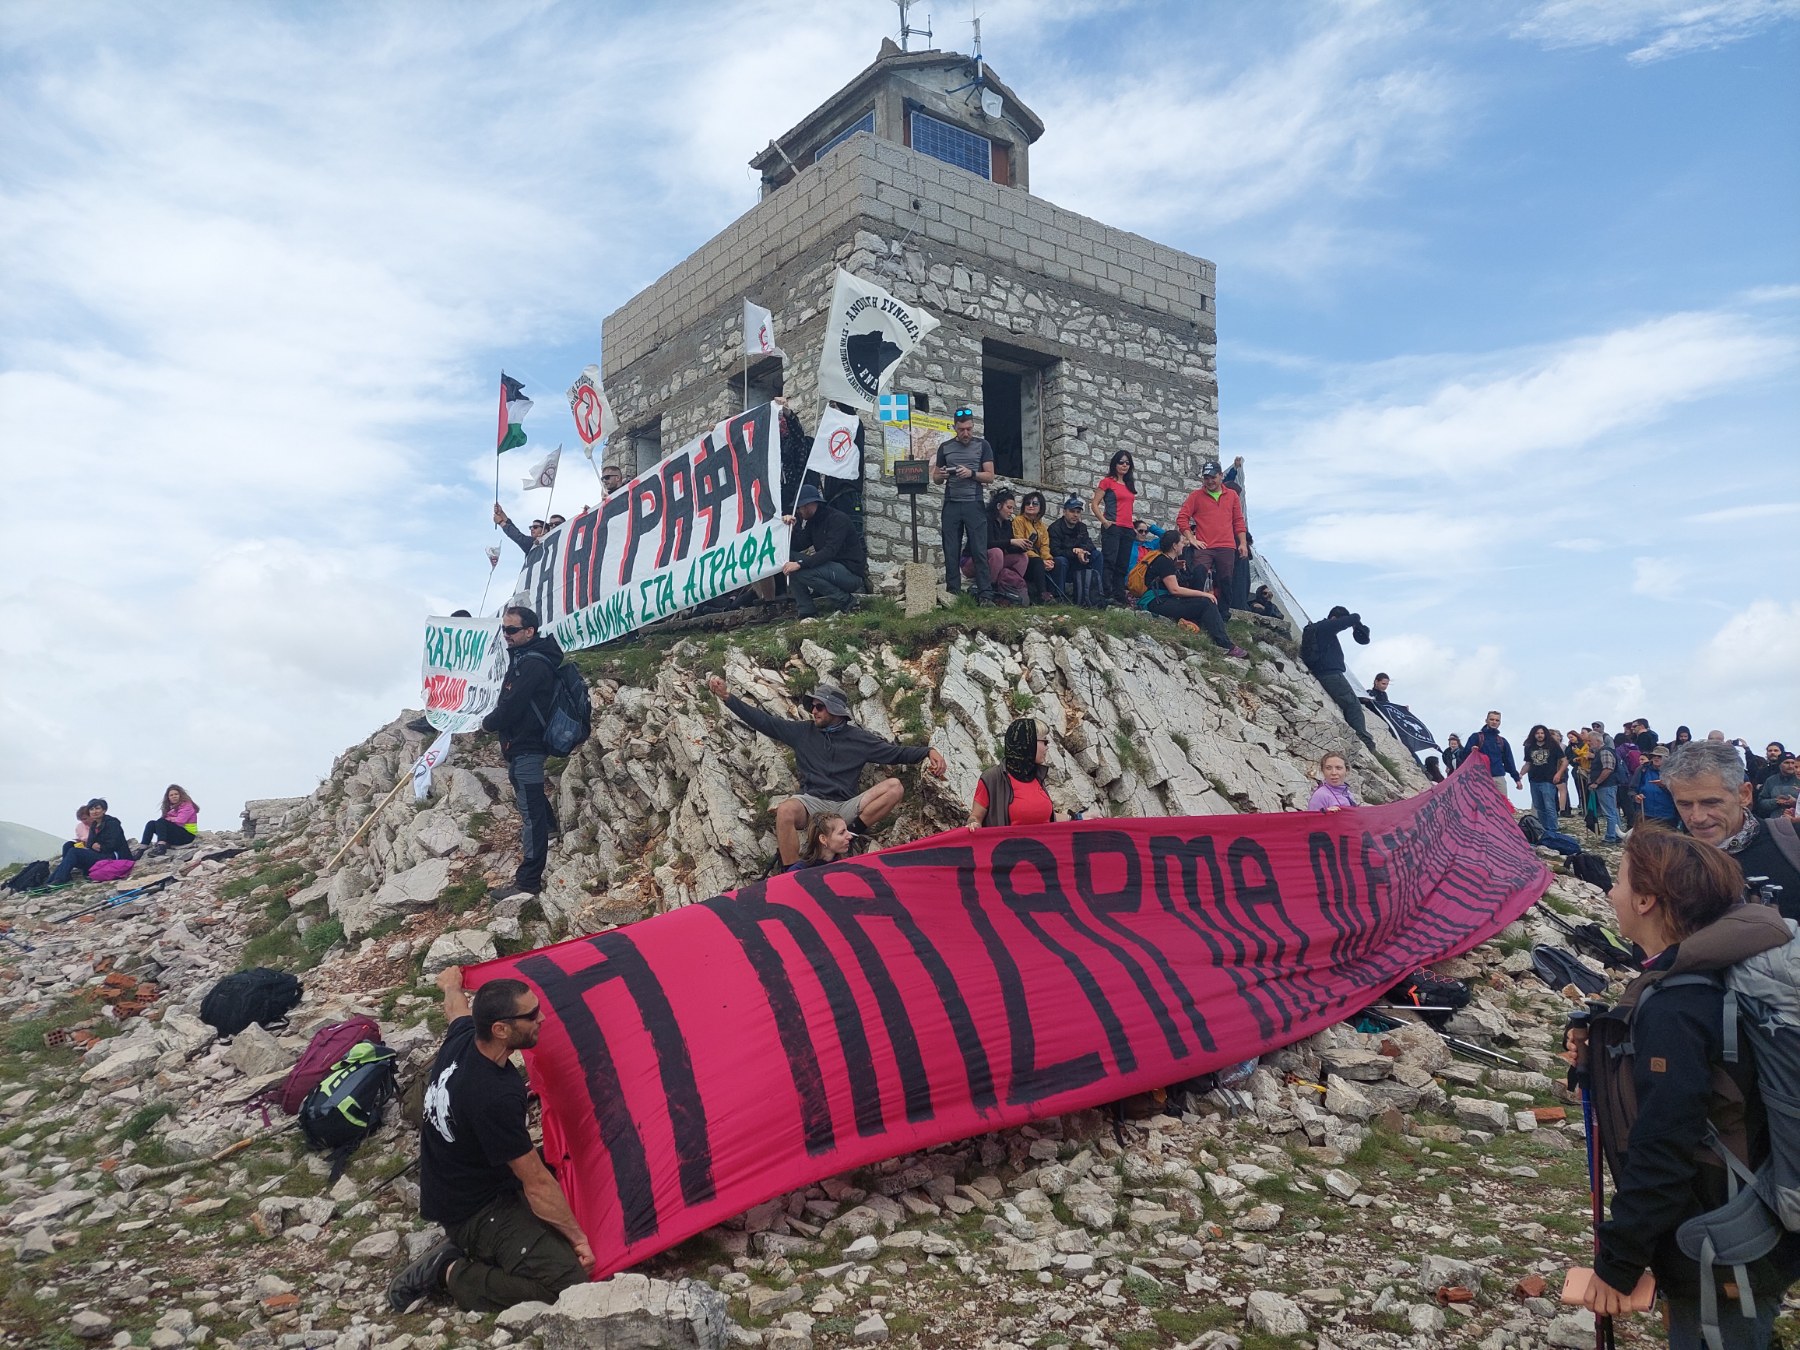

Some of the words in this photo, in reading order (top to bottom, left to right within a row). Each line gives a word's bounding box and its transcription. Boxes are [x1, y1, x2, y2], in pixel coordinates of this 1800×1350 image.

[562, 401, 777, 615] ΑΓΡΑΦΑ
[585, 588, 636, 644] ΑΙΟΛΙΚΑ
[640, 570, 677, 623] ΣΤΑ
[682, 525, 777, 606] ΑΓΡΑΦΑ
[514, 930, 717, 1246] Η
[698, 829, 1345, 1157] ΚΑΖΑΡΜΑ
